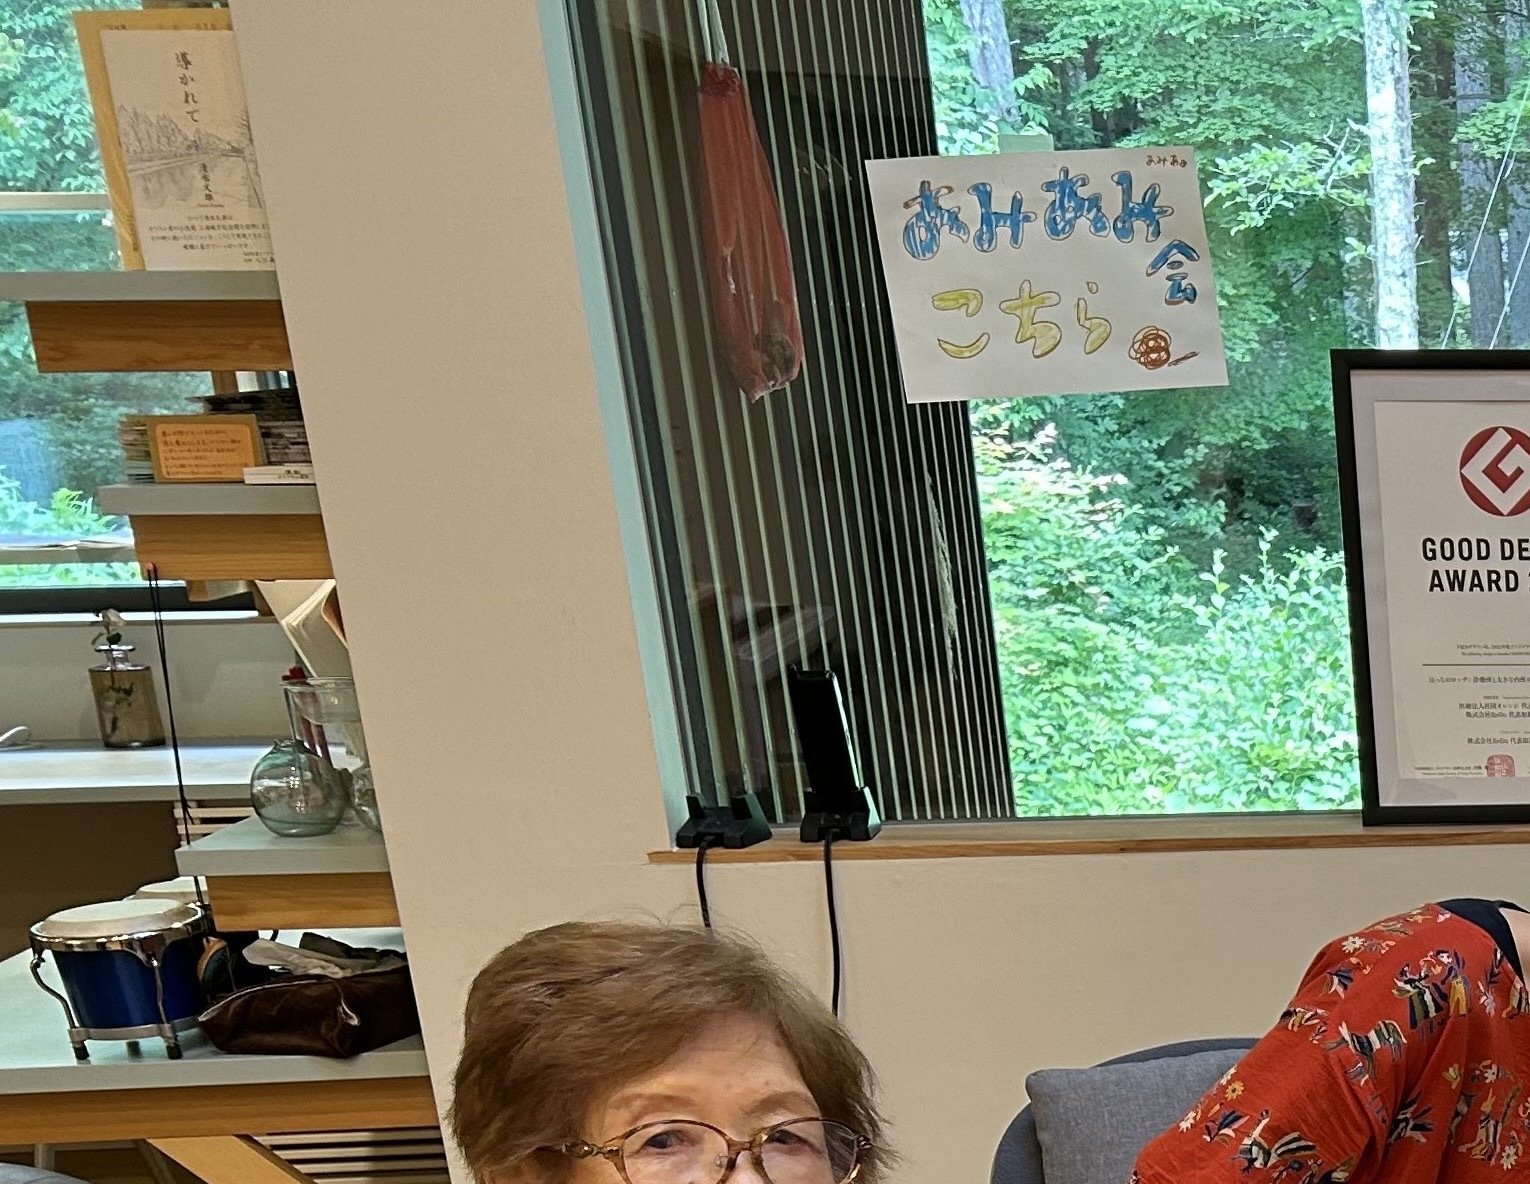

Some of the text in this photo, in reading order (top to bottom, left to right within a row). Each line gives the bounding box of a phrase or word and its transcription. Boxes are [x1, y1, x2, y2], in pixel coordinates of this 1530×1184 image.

[174, 51, 200, 123] 導かれて
[903, 166, 1174, 261] あみあみ
[1145, 239, 1200, 306] 会
[931, 279, 1112, 359] こちら
[1422, 537, 1491, 562] GOOD
[1429, 569, 1519, 593] AWARD
